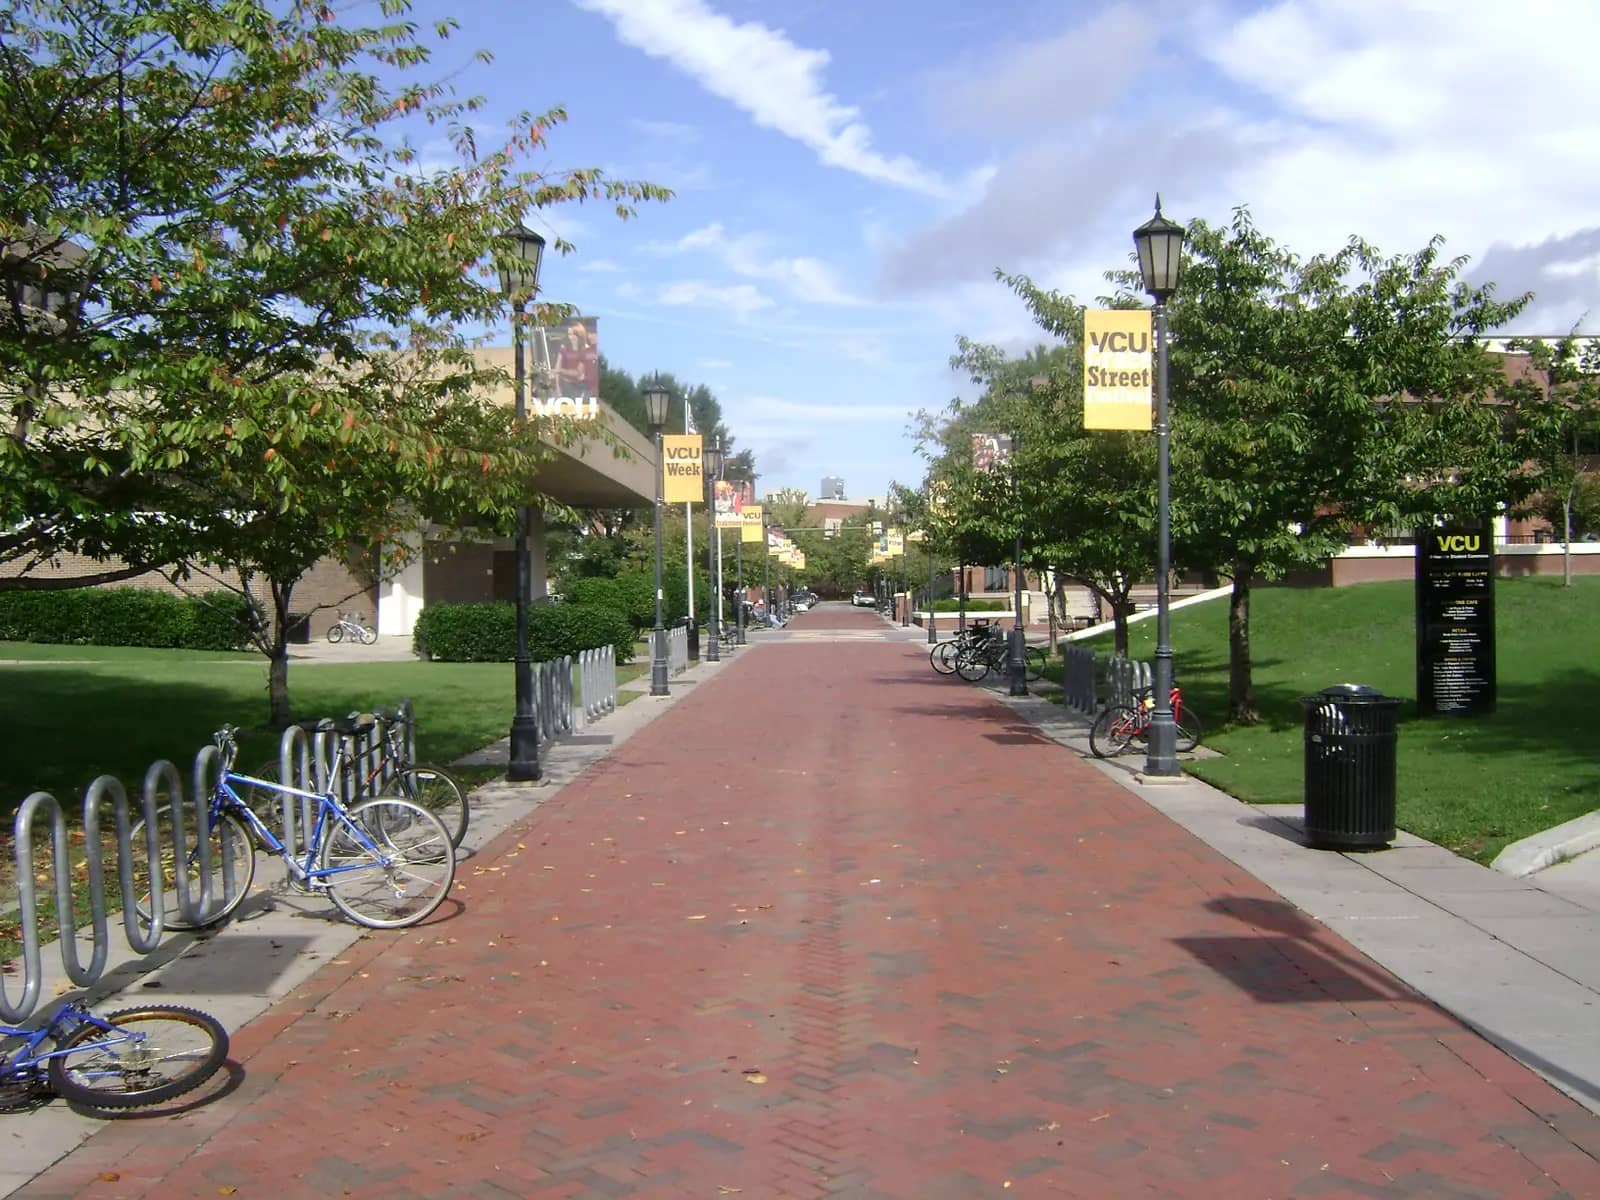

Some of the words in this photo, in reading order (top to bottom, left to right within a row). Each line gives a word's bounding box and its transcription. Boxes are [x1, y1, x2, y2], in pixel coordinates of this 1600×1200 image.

[1089, 331, 1147, 353] VCU
[1087, 365, 1149, 387] Street
[532, 397, 597, 419] VCU
[666, 447, 700, 459] VCU
[666, 462, 700, 476] Week
[1437, 535, 1480, 551] VCU
